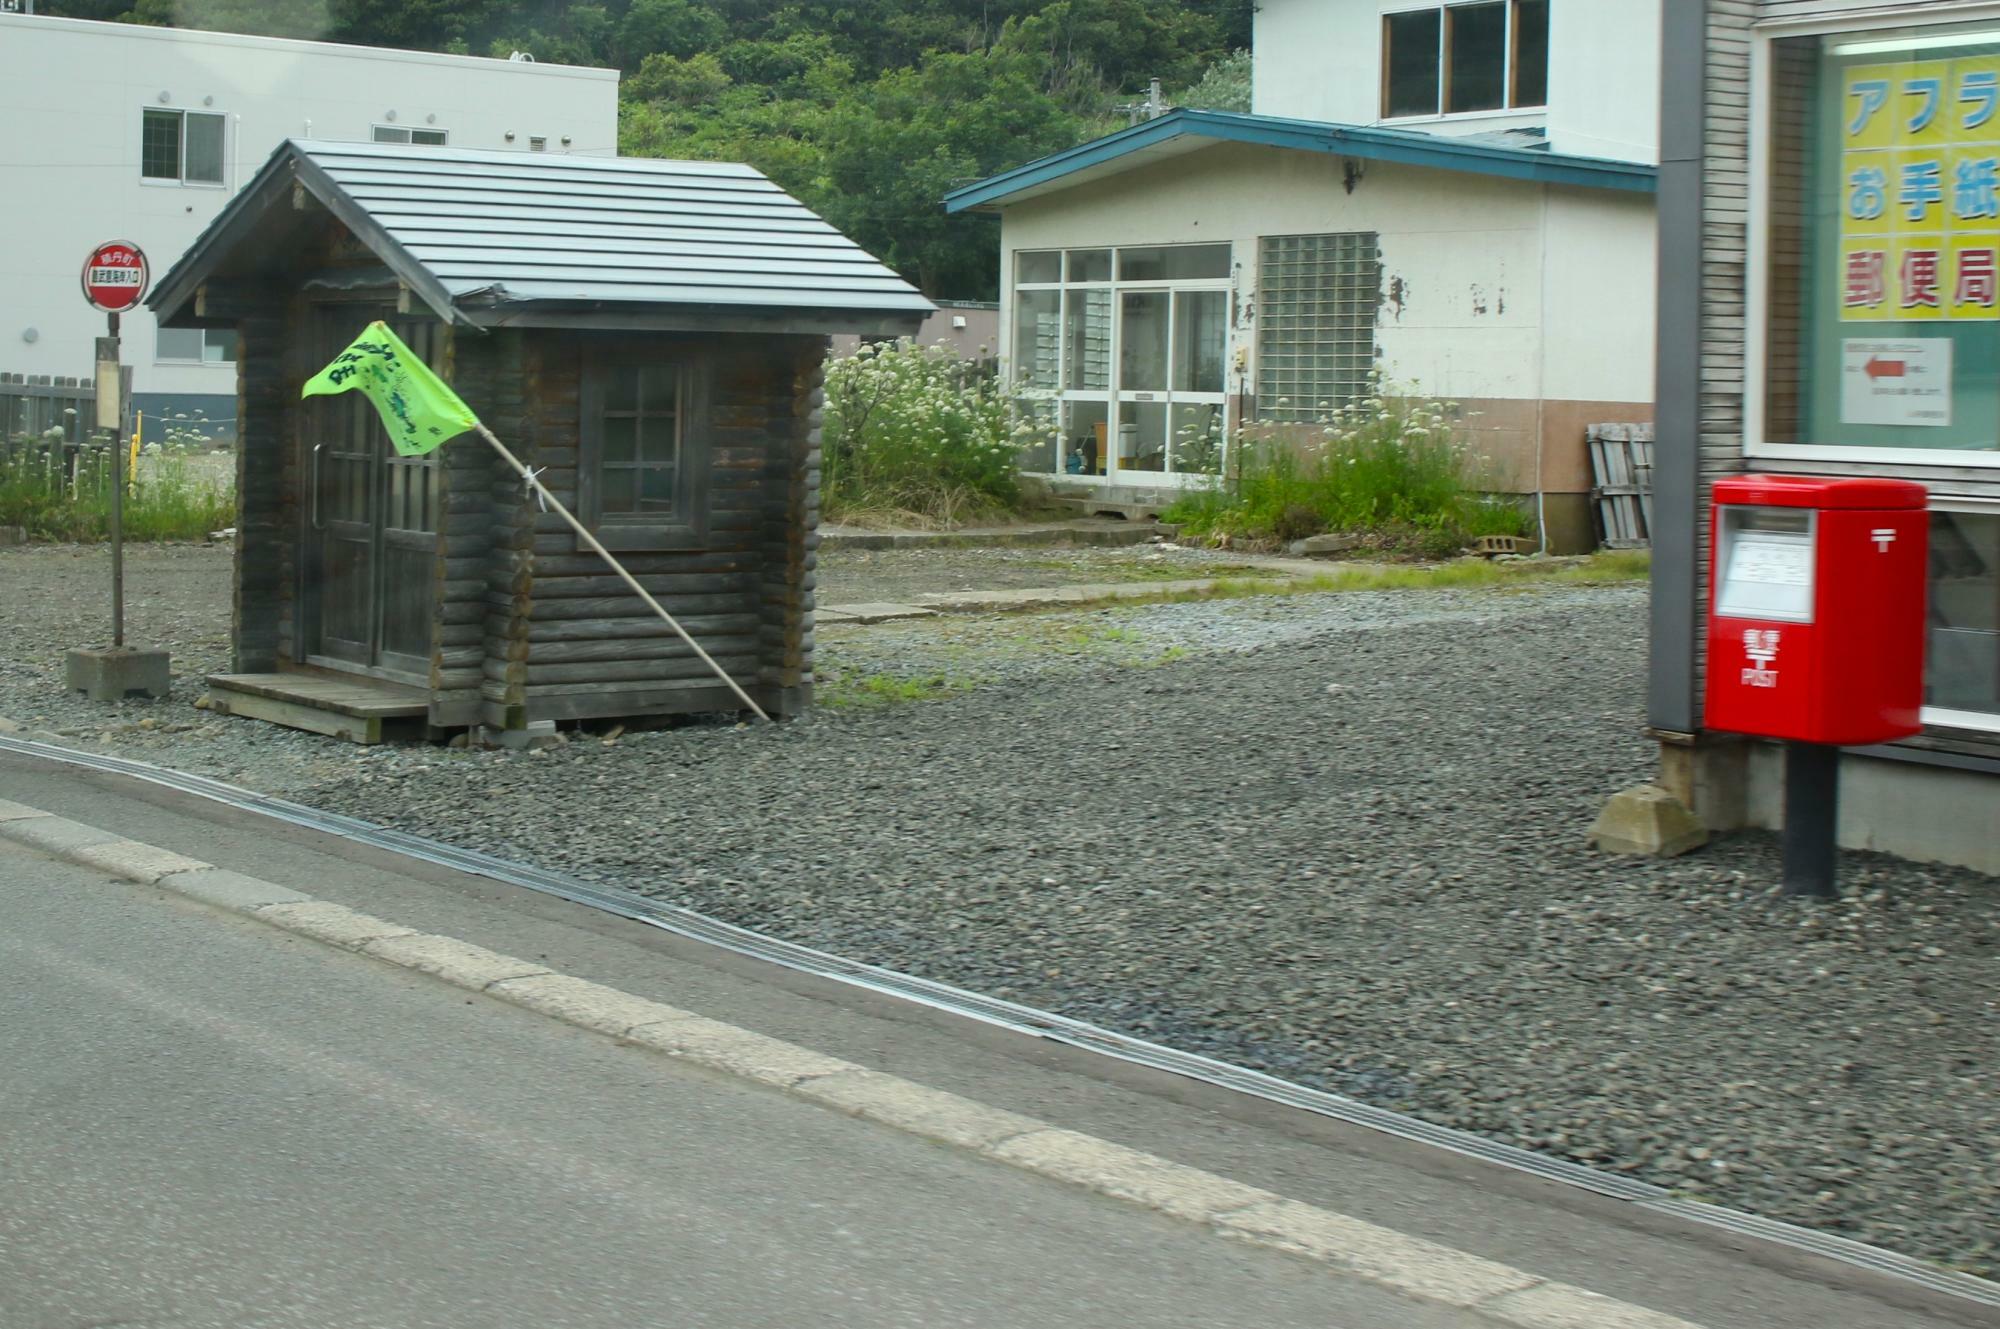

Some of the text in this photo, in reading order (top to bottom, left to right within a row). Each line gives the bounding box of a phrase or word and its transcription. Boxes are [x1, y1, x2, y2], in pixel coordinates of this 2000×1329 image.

[1848, 71, 1998, 136] アフラ
[1847, 157, 2000, 221] お手紙
[1843, 249, 1997, 310] 郵便局
[1743, 629, 1781, 651] 郵便
[1741, 668, 1780, 688] POST
